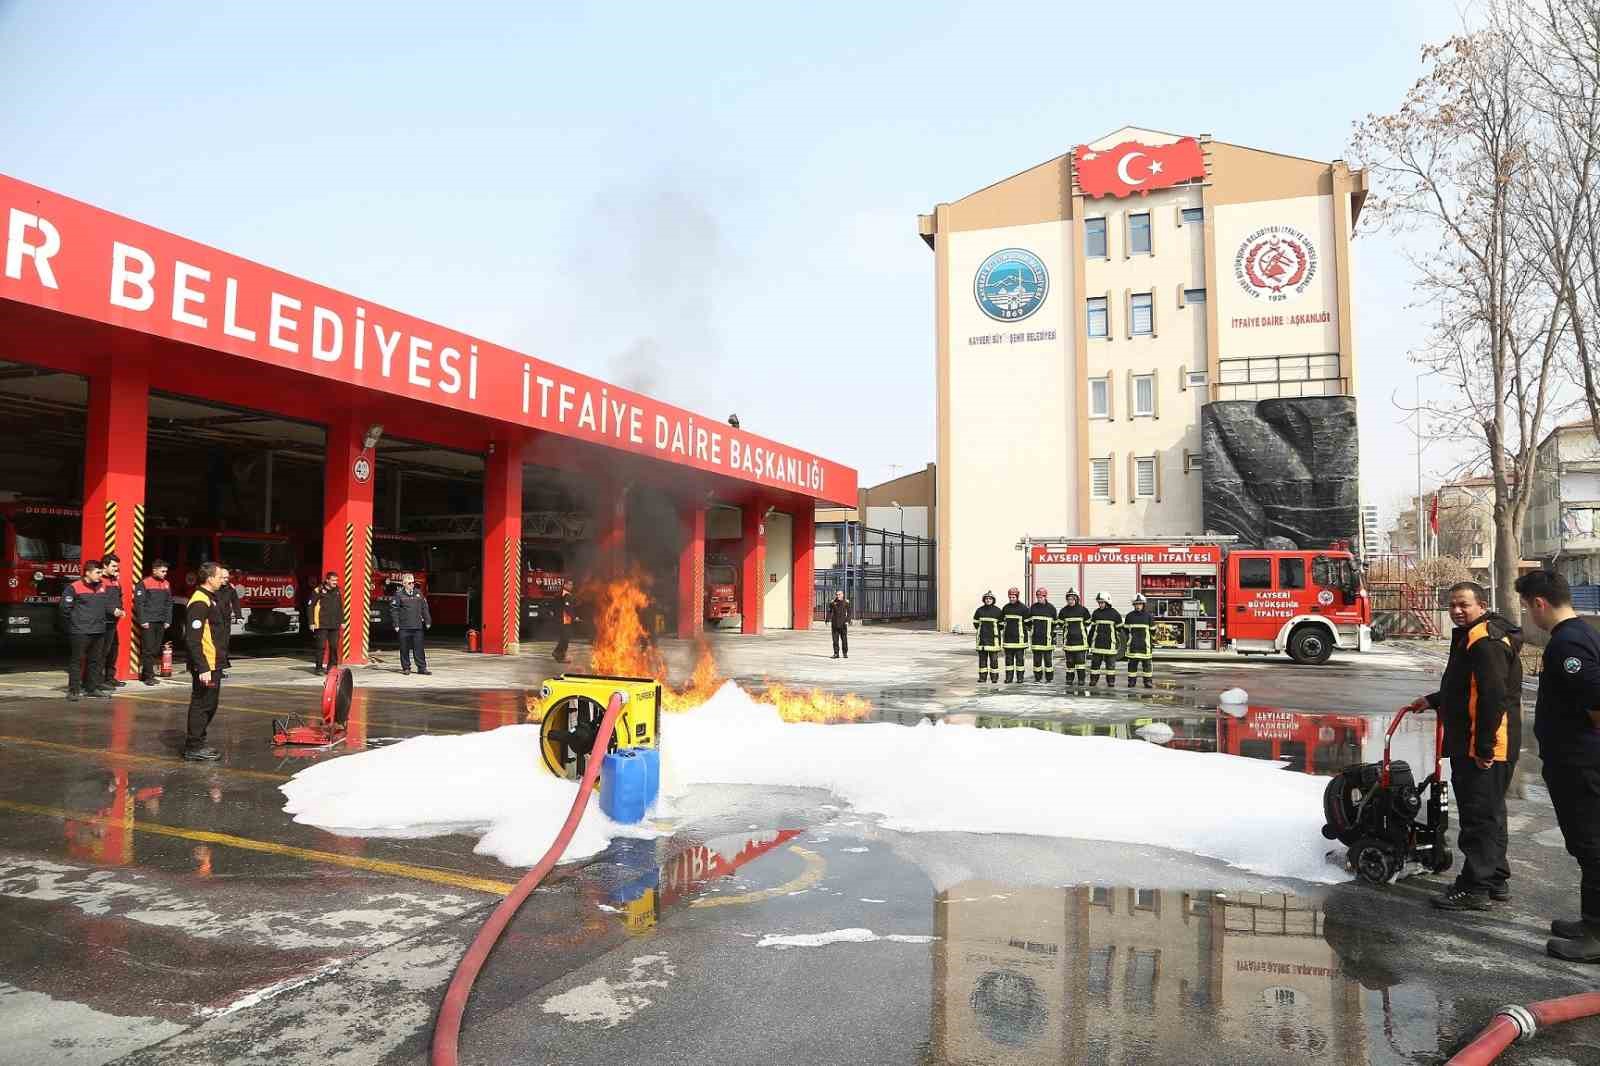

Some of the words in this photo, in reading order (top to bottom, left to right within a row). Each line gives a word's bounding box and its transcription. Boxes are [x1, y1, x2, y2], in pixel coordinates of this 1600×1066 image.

[1231, 315, 1260, 328] İTFAİYE
[1261, 313, 1284, 327] DAİRE
[109, 241, 479, 400] BELEDİYESİ
[521, 362, 644, 444] İTFAİYE
[655, 415, 722, 465] DAİRE
[730, 438, 824, 493] BAŞKANLIĞI
[1039, 551, 1082, 562] KAYSERİ
[1087, 550, 1154, 563] BÜYÜKŞEHİR
[1159, 551, 1211, 562] İTFAİYESİ
[1256, 591, 1291, 599] KAYSERİ
[1248, 600, 1299, 608] BÜYÜKŞEHİR
[1254, 609, 1293, 617] İTFAİYESİ
